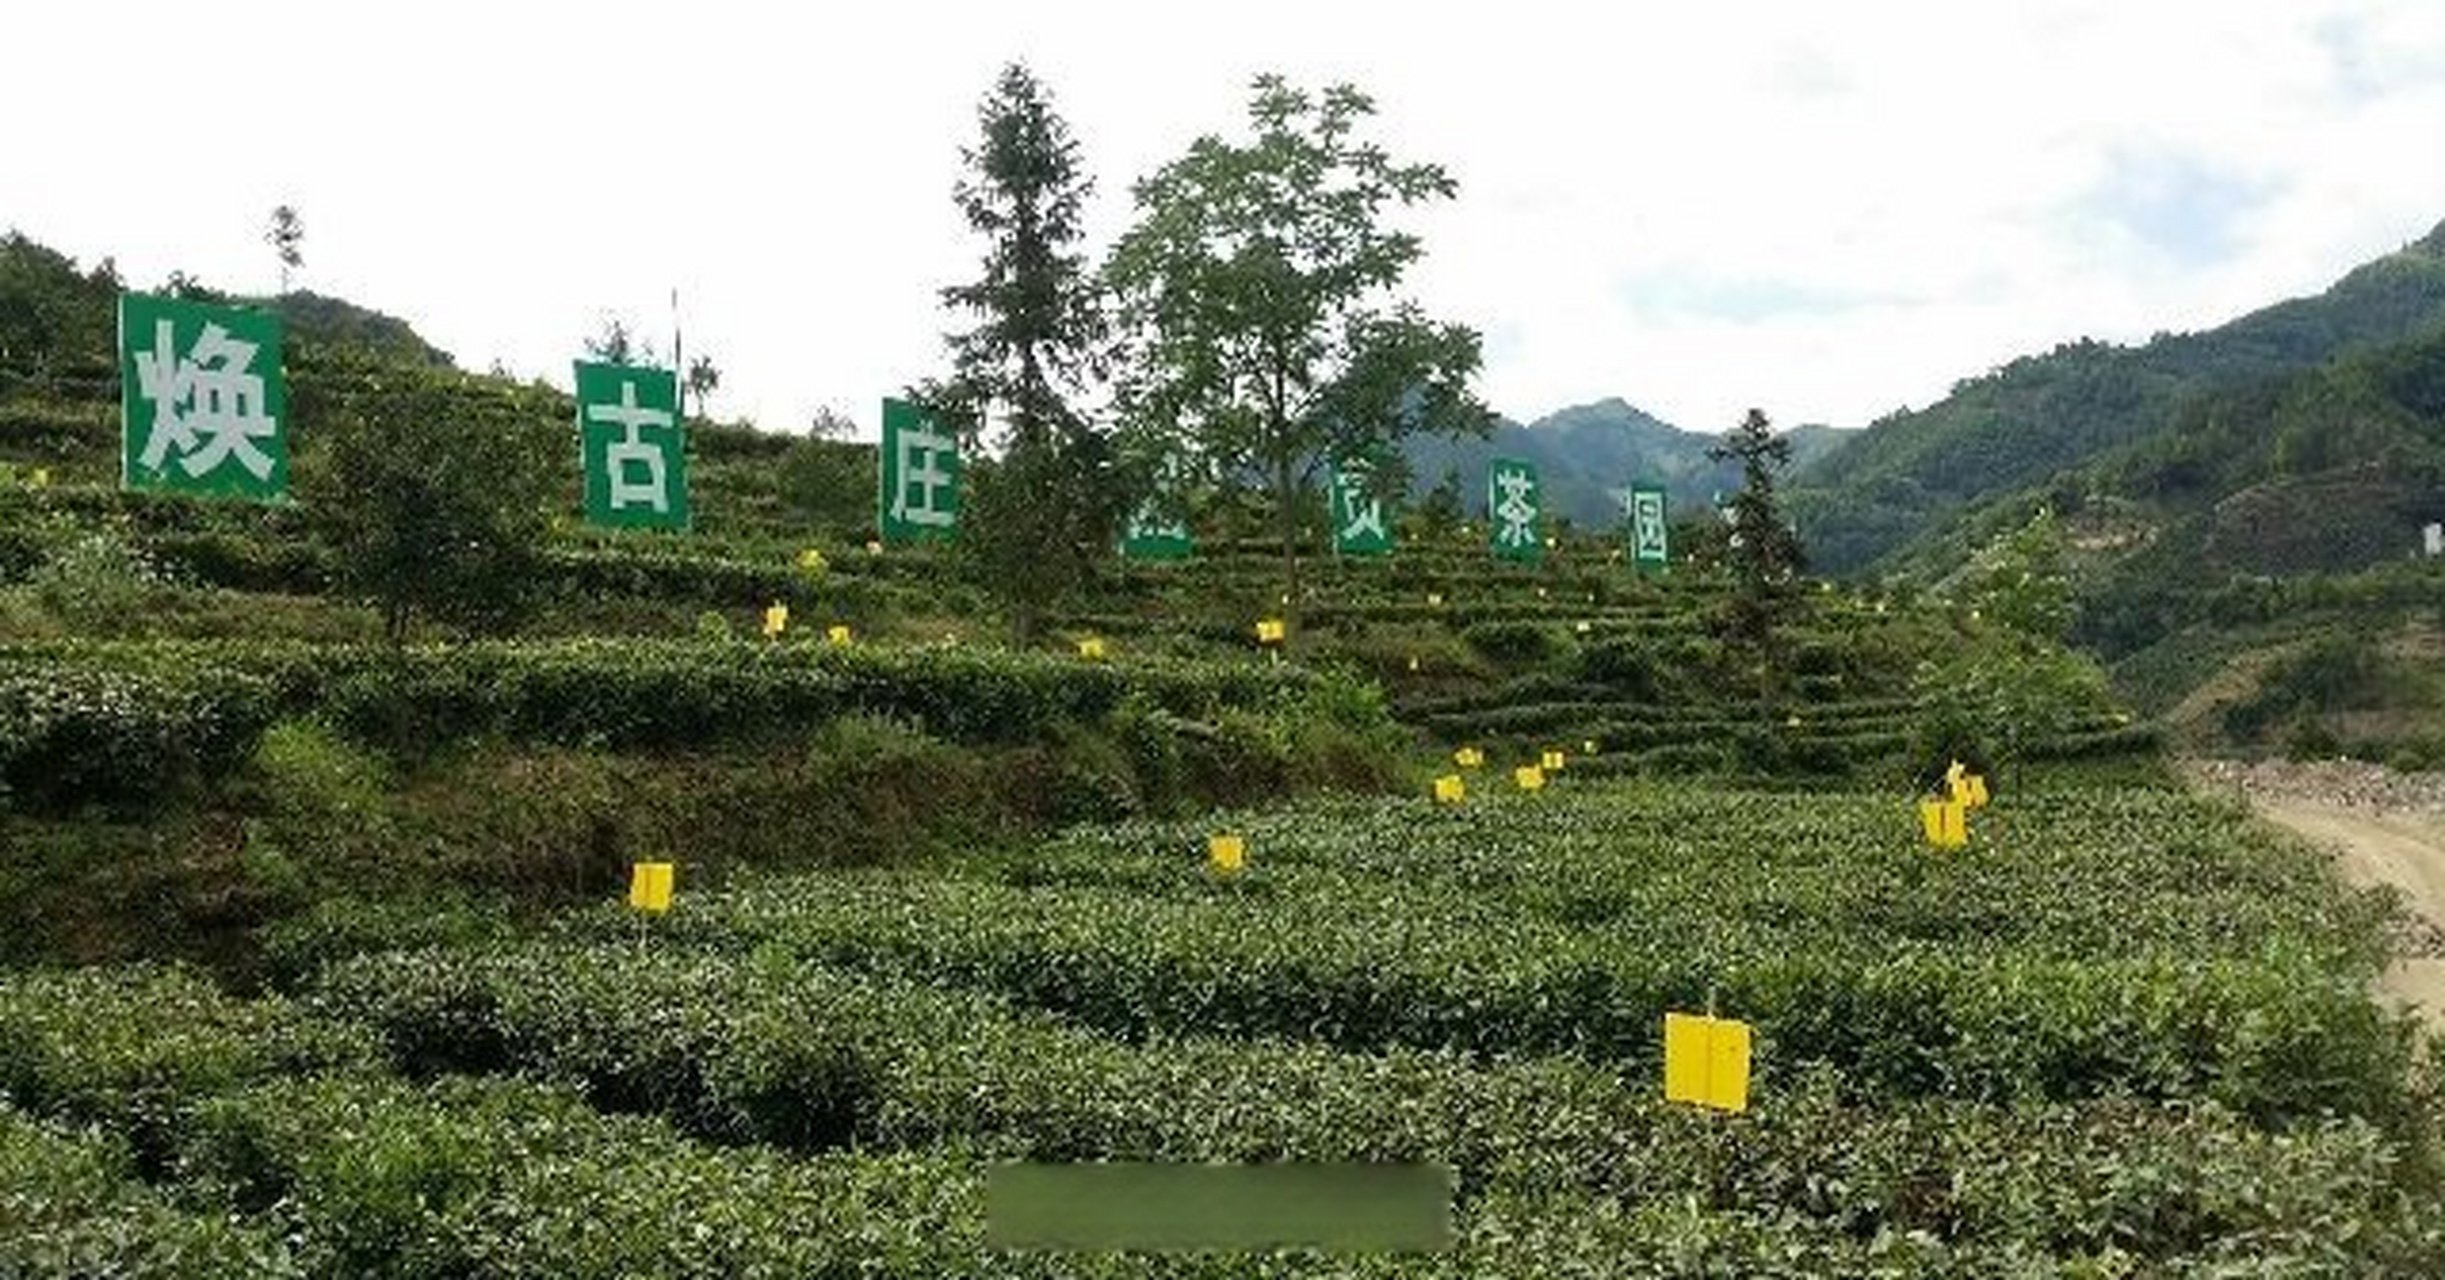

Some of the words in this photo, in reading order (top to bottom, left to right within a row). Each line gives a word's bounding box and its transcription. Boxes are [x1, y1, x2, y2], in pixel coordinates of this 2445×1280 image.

[135, 319, 276, 480] 焕
[586, 380, 675, 512] 古
[890, 419, 956, 527] 庄
[1497, 468, 1537, 547] 茶
[1634, 491, 1667, 562] 园
